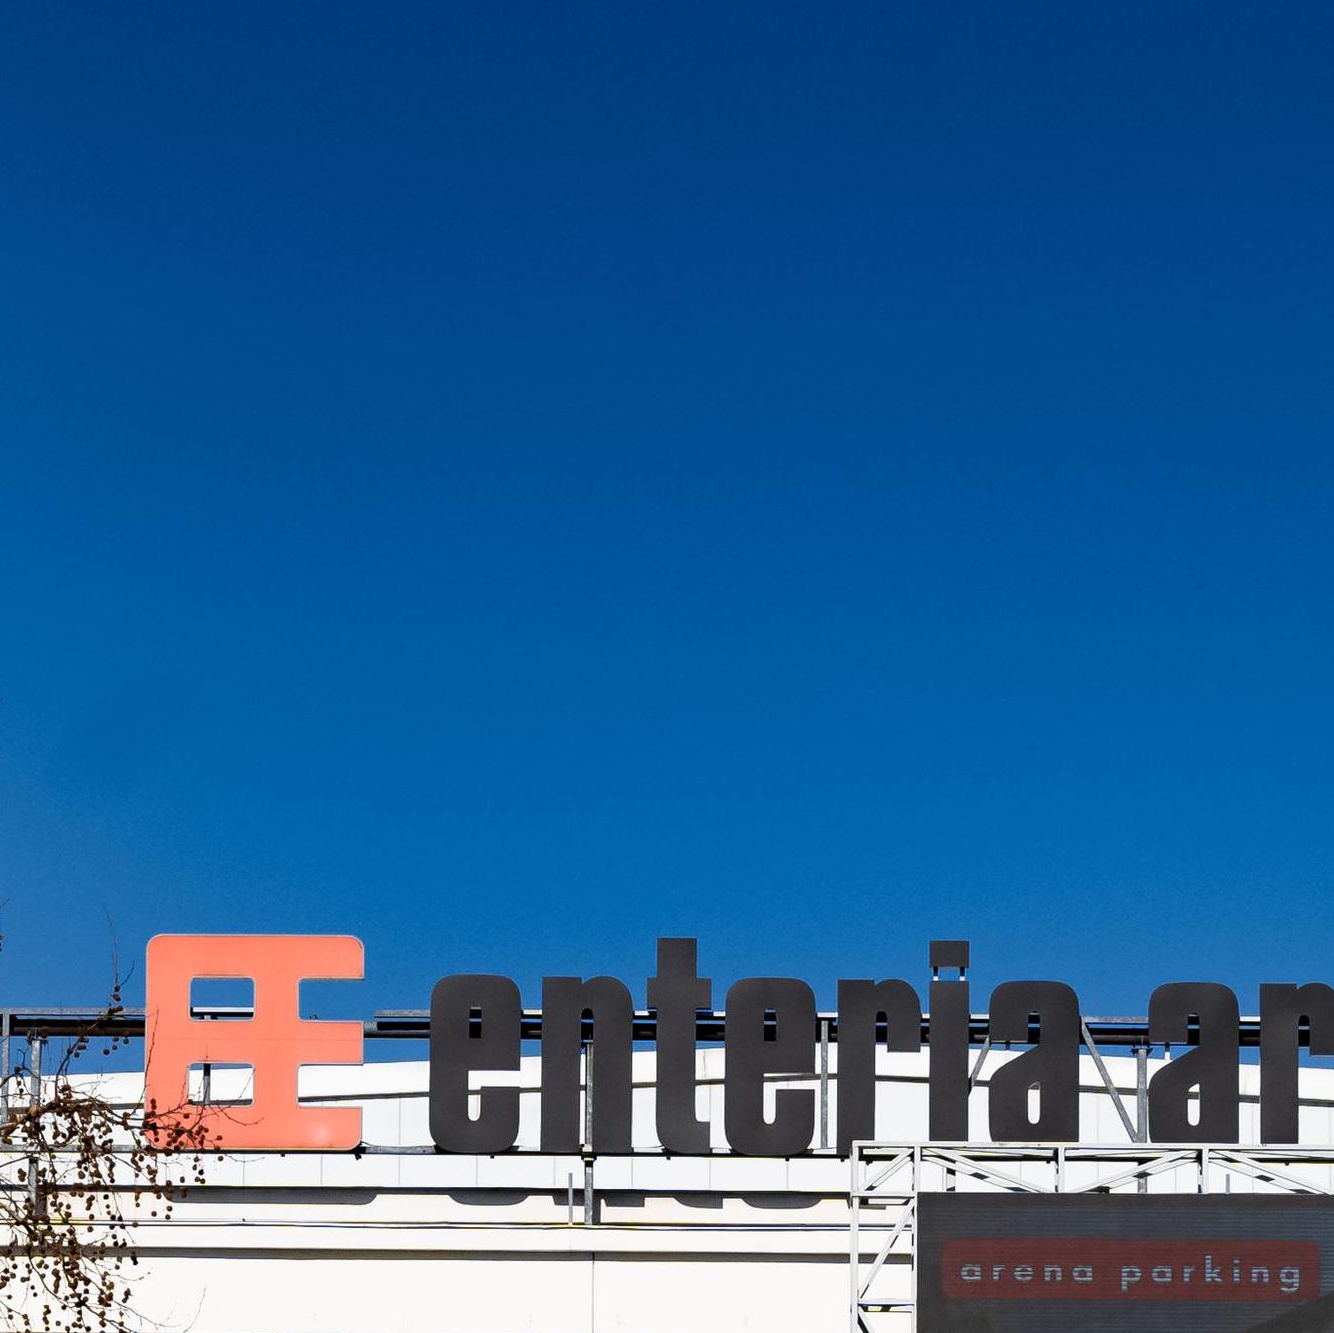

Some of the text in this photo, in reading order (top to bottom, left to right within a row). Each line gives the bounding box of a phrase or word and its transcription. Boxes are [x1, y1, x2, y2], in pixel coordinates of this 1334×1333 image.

[429, 937, 1080, 1155] enteria
[960, 1255, 1301, 1293] arena parking
